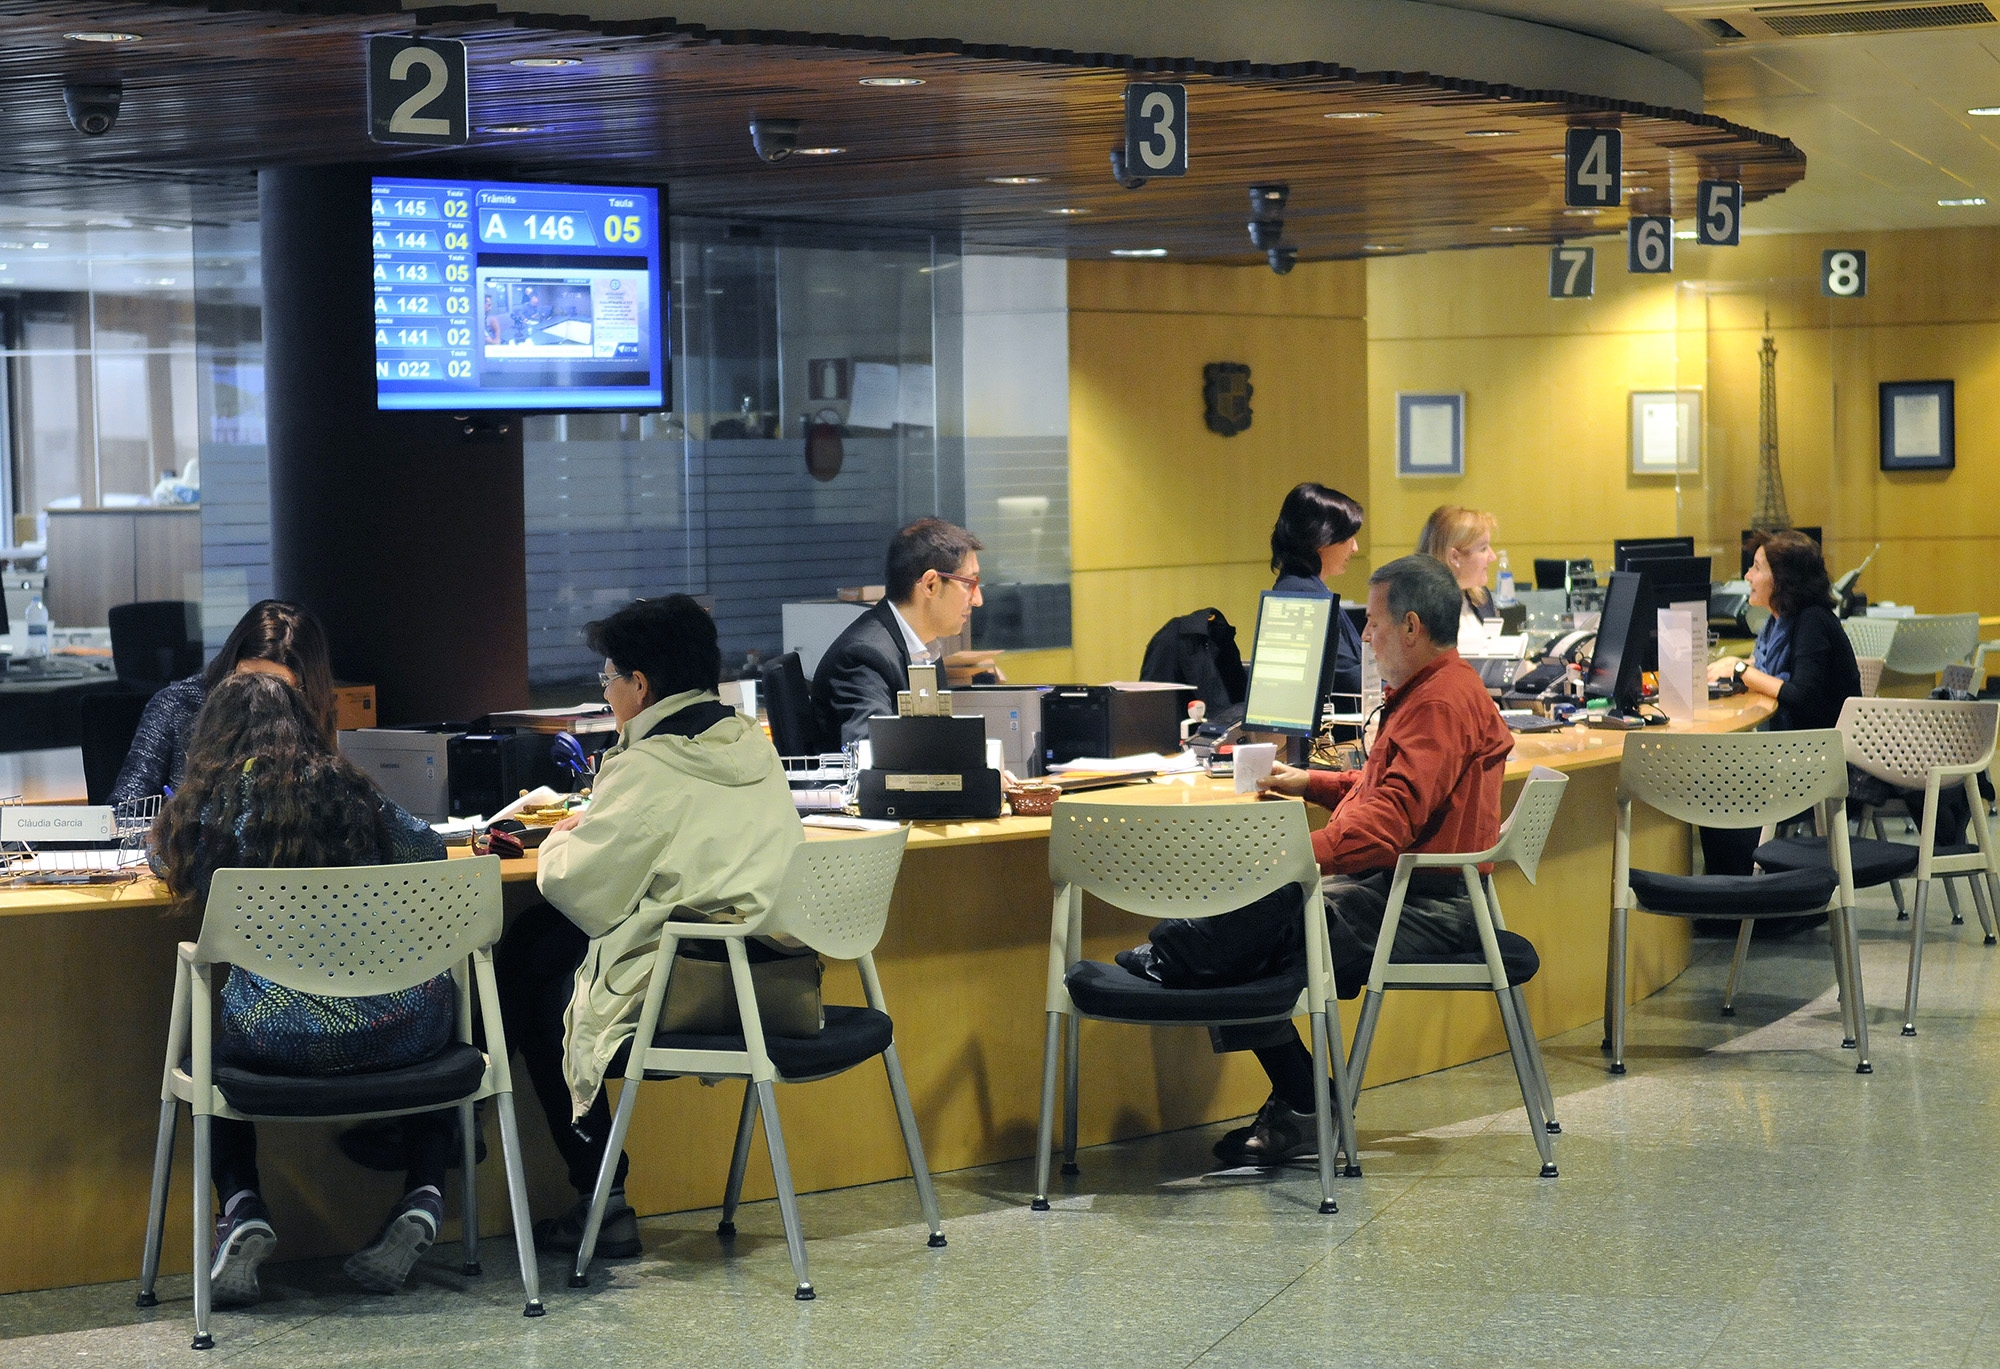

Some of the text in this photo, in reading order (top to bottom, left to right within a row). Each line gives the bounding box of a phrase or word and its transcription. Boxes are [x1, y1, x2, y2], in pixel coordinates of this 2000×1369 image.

[390, 46, 450, 135] 2
[1139, 92, 1176, 169] 3
[1578, 136, 1612, 200] 4
[372, 199, 468, 217] A 145 02
[481, 194, 633, 208] Tràmits Taula
[1706, 186, 1733, 241] 5
[484, 213, 641, 243] A 146 05
[372, 231, 468, 250] A 144 04
[1638, 220, 1666, 270] 6
[374, 264, 469, 282] A 143 05
[1560, 251, 1586, 295] 7
[1828, 252, 1860, 295] 8
[374, 296, 470, 314] A 142 03
[375, 328, 470, 346] A 141 02
[376, 360, 471, 377] N 022 02
[54, 818, 82, 828] Garcia
